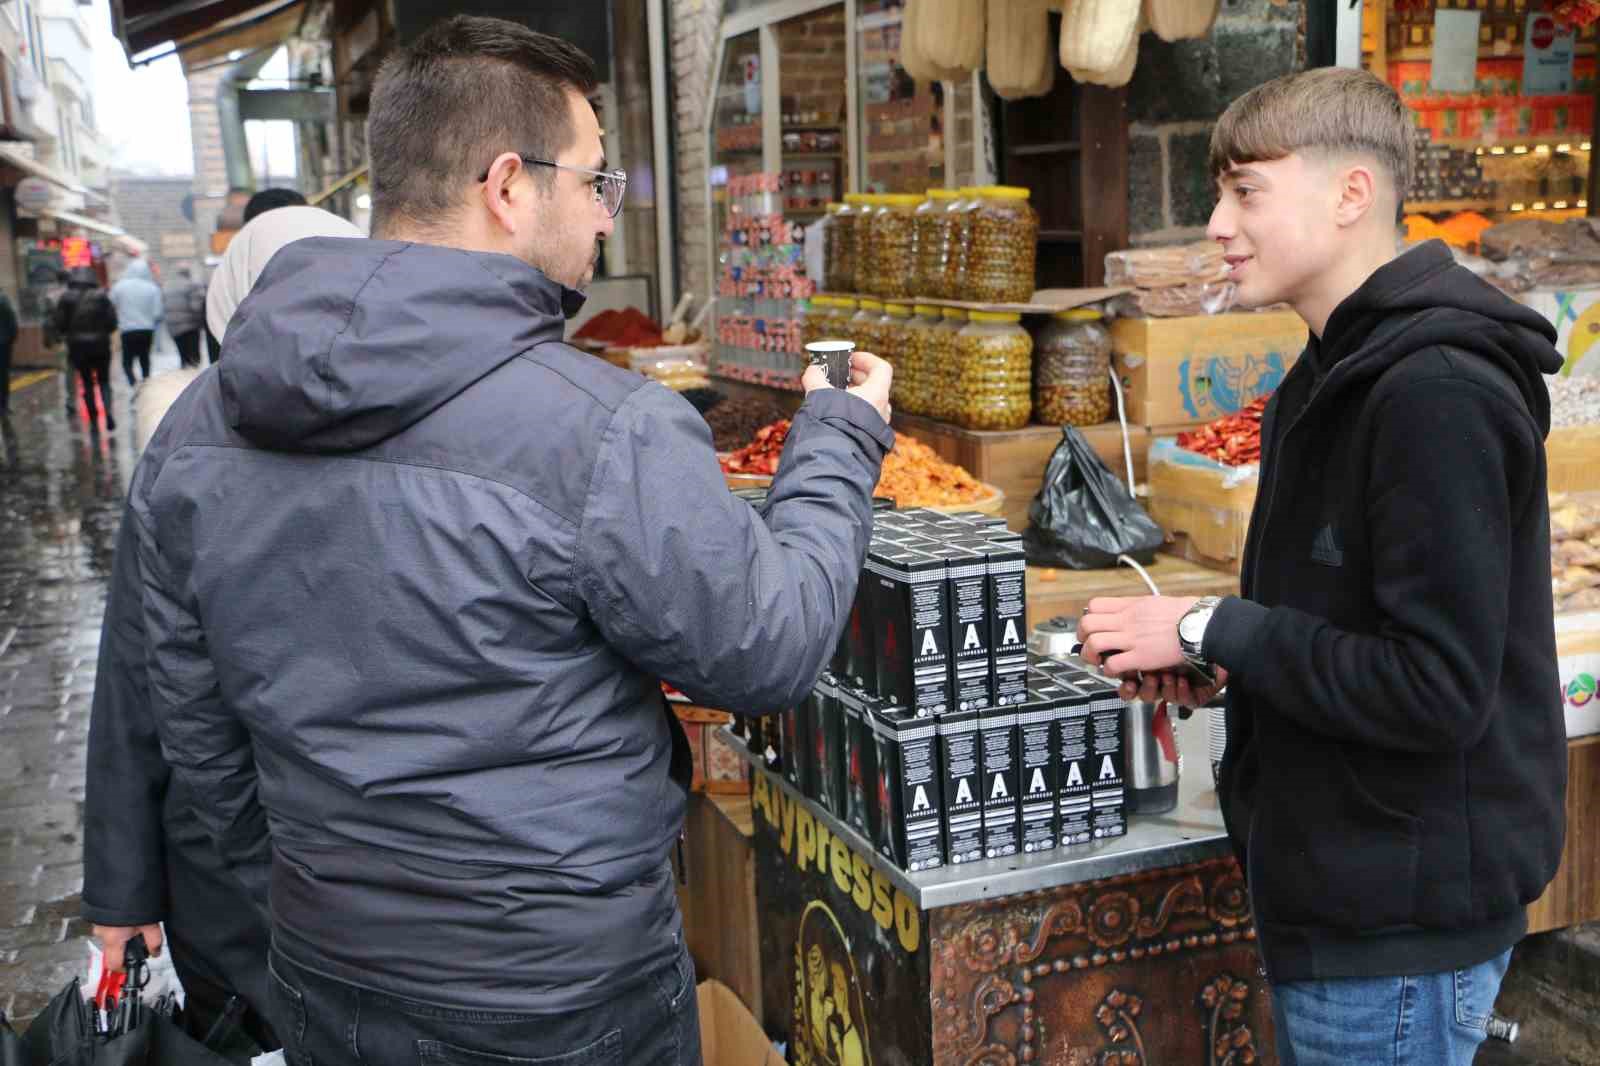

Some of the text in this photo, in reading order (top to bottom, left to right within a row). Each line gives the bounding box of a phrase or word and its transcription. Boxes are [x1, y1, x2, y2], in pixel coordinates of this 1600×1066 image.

[921, 629, 938, 655] A
[964, 624, 980, 649] A
[1003, 619, 1019, 644] A
[1067, 762, 1083, 786] A
[1099, 755, 1116, 779] A
[956, 778, 973, 803] A
[991, 773, 1008, 798] A
[1030, 768, 1046, 793] A
[913, 785, 929, 811] A
